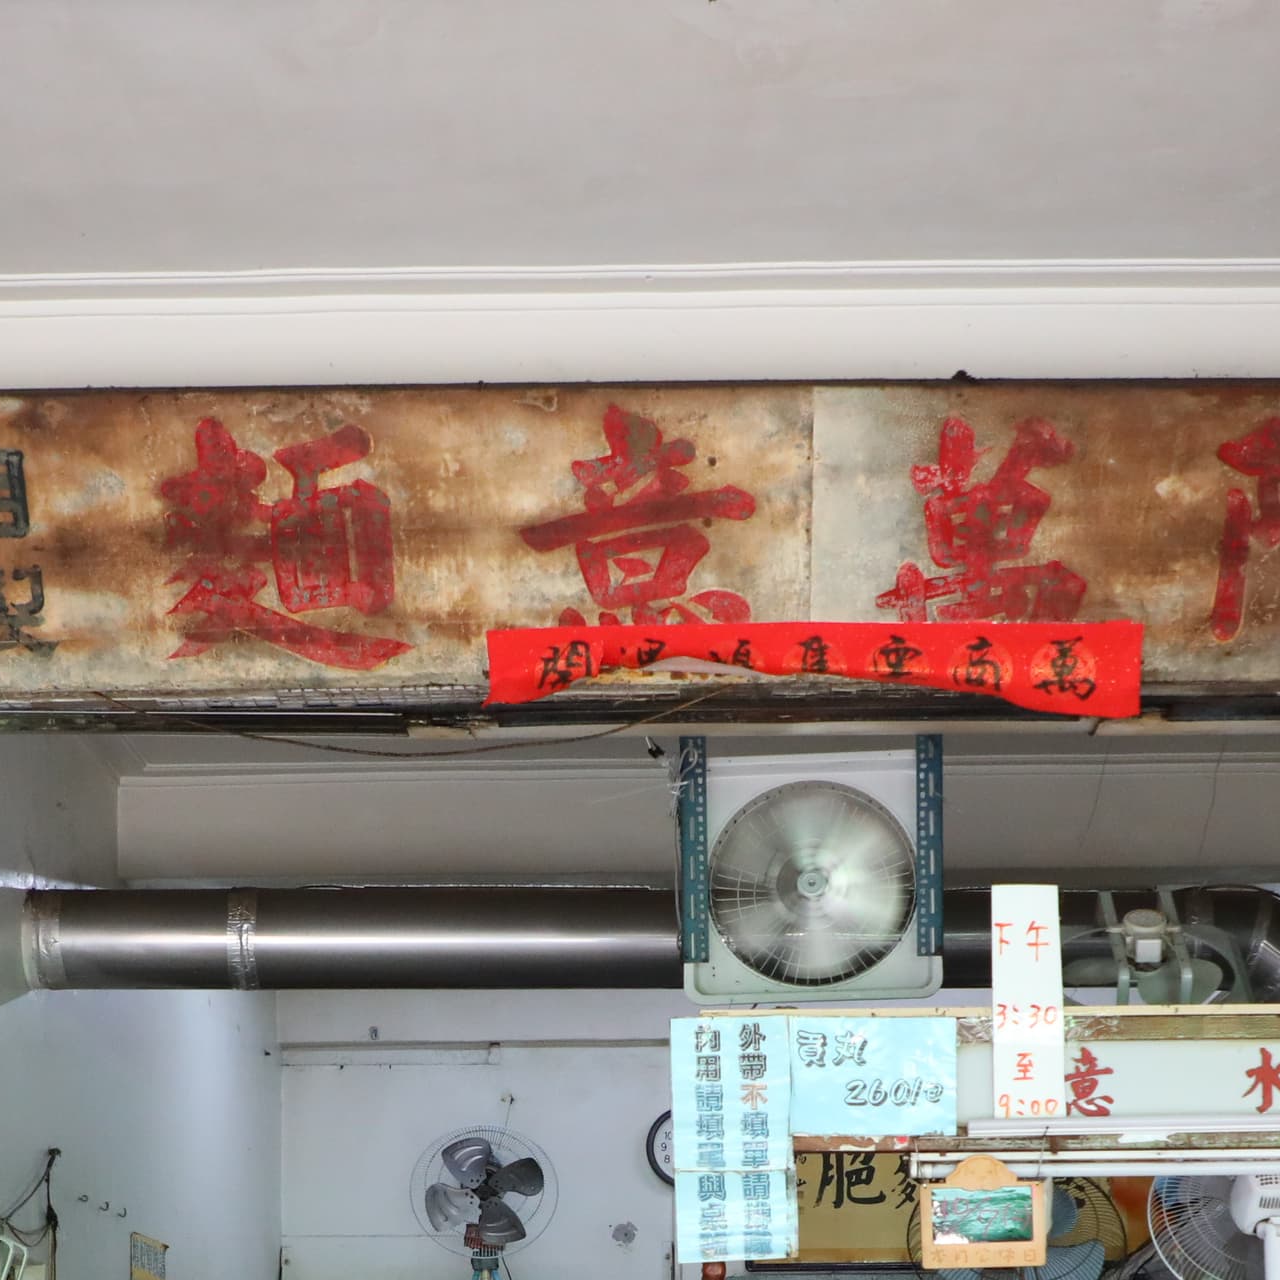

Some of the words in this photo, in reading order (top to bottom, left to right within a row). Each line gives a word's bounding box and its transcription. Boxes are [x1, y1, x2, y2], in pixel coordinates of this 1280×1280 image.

[994, 920, 1050, 962] 下午
[996, 1003, 1057, 1029] 3:30
[1013, 1052, 1035, 1081] 至
[998, 1094, 1059, 1119] 9:00
